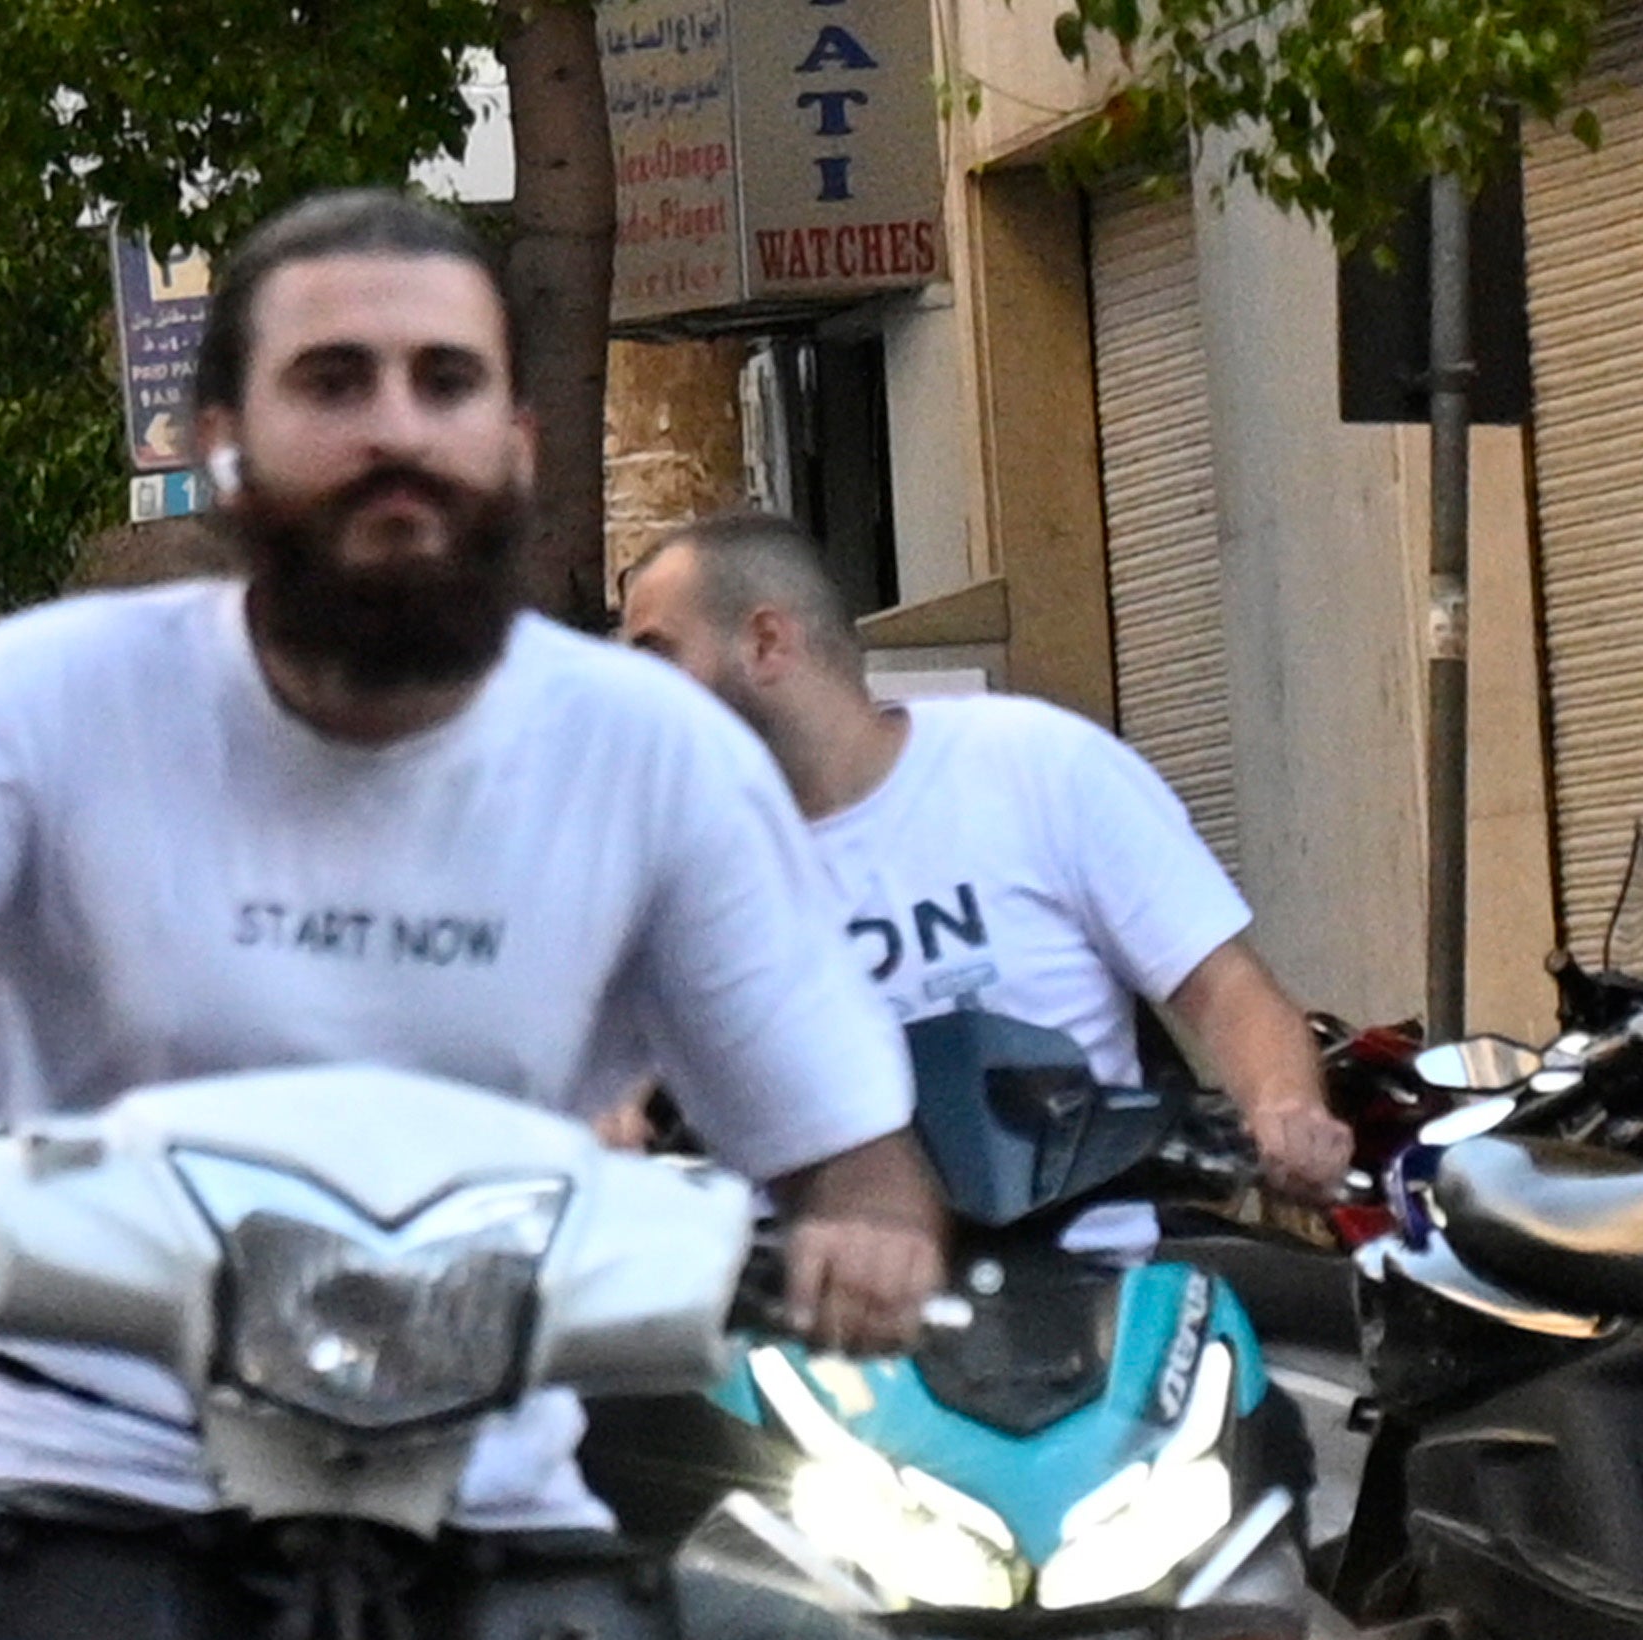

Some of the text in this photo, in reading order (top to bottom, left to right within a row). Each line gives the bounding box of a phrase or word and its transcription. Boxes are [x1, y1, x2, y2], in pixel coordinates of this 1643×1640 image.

[793, 0, 879, 202] ATI
[755, 221, 937, 281] WATCHES
[233, 902, 505, 967] START NOW
